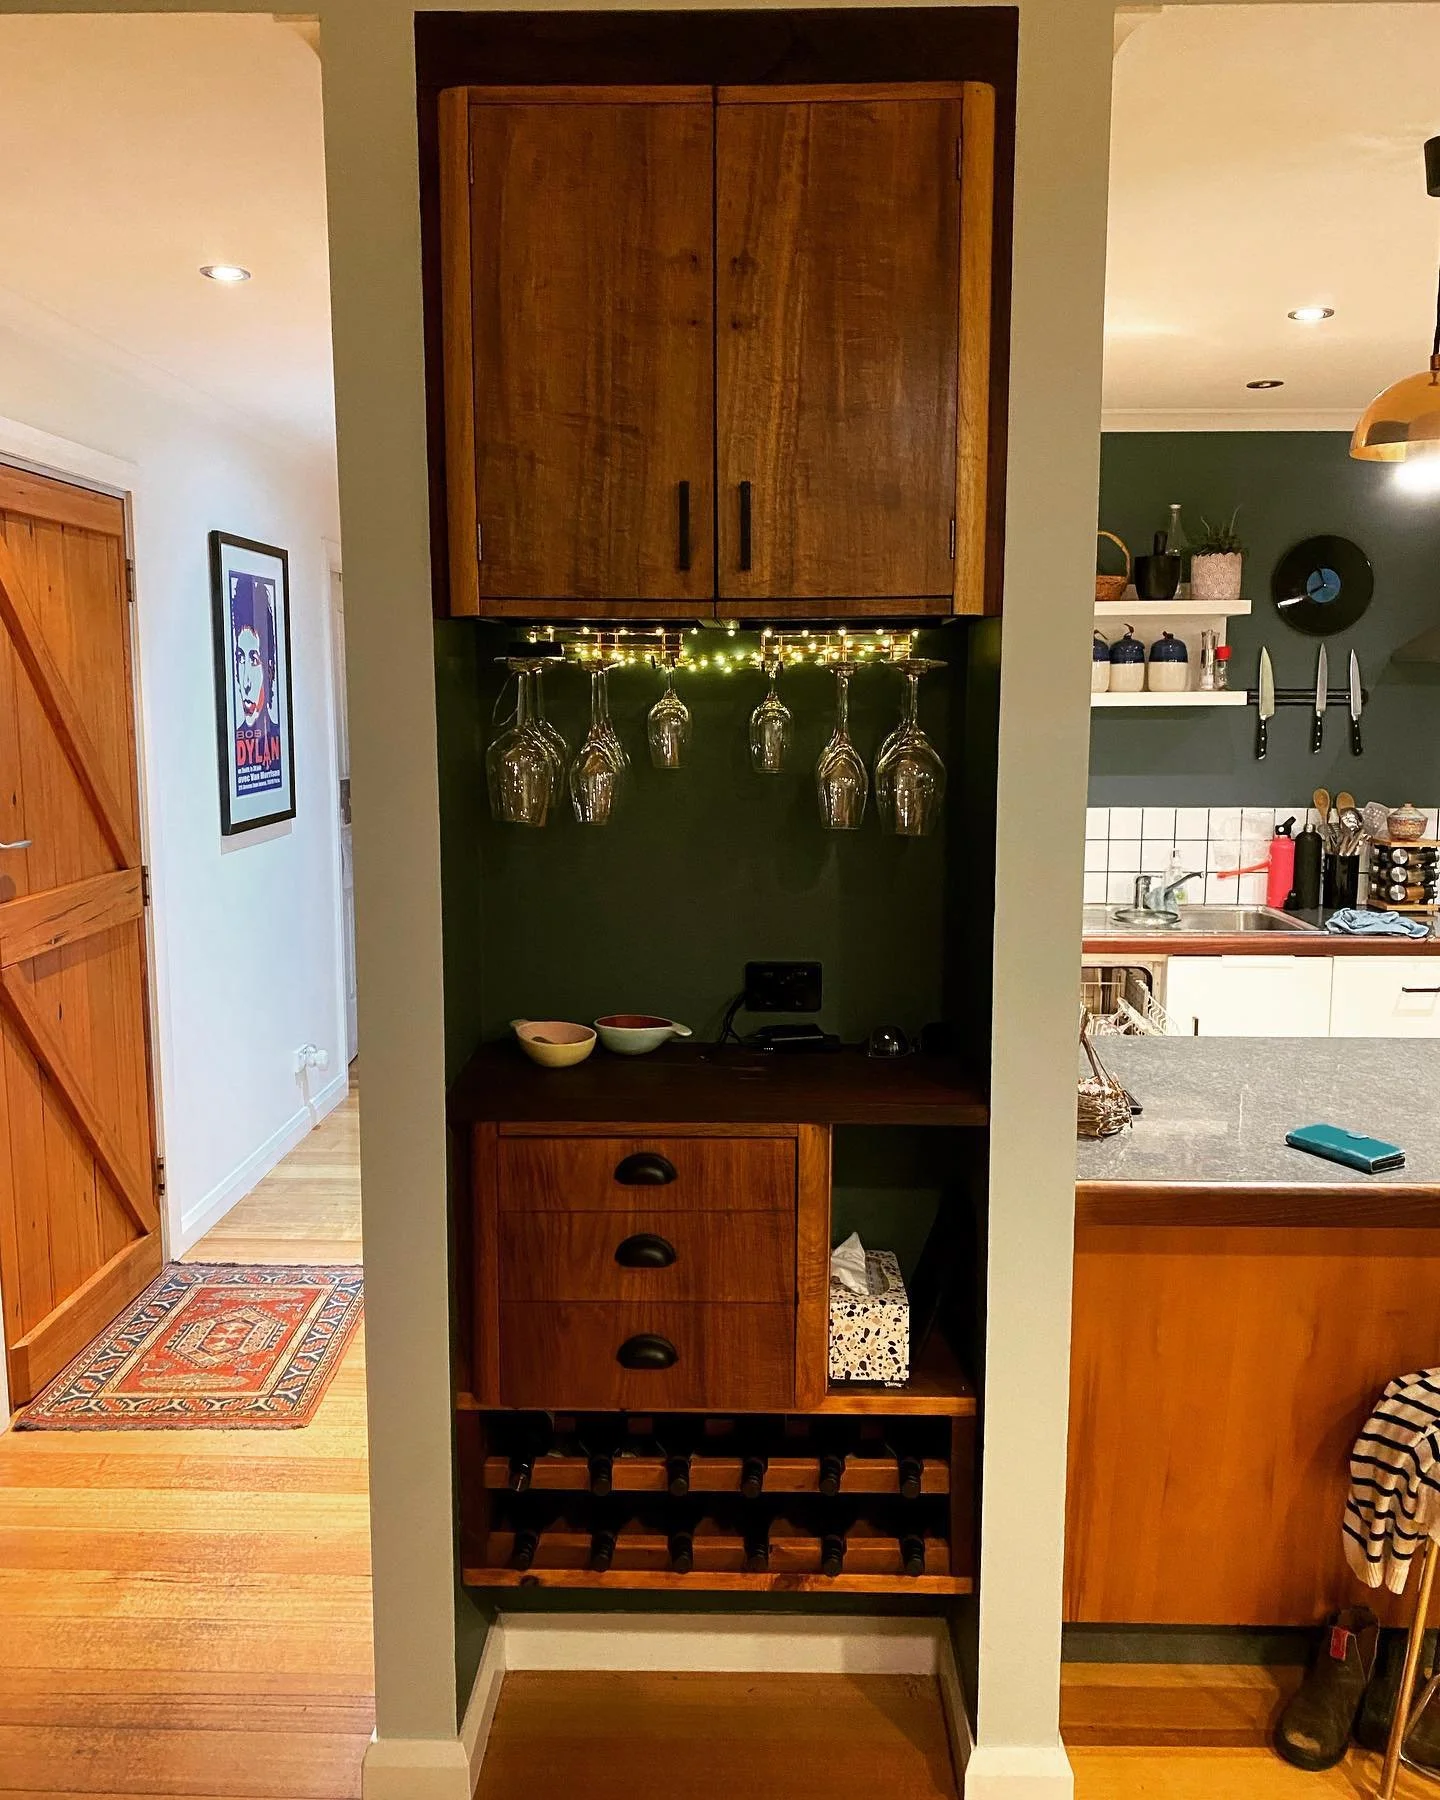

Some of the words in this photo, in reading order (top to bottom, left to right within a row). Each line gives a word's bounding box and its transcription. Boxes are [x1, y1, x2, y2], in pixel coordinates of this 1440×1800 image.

[236, 729, 262, 739] BOB
[236, 736, 279, 769] DYLAN
[237, 775, 250, 783] avec
[250, 773, 260, 781] Van
[260, 770, 280, 779] Morrison
